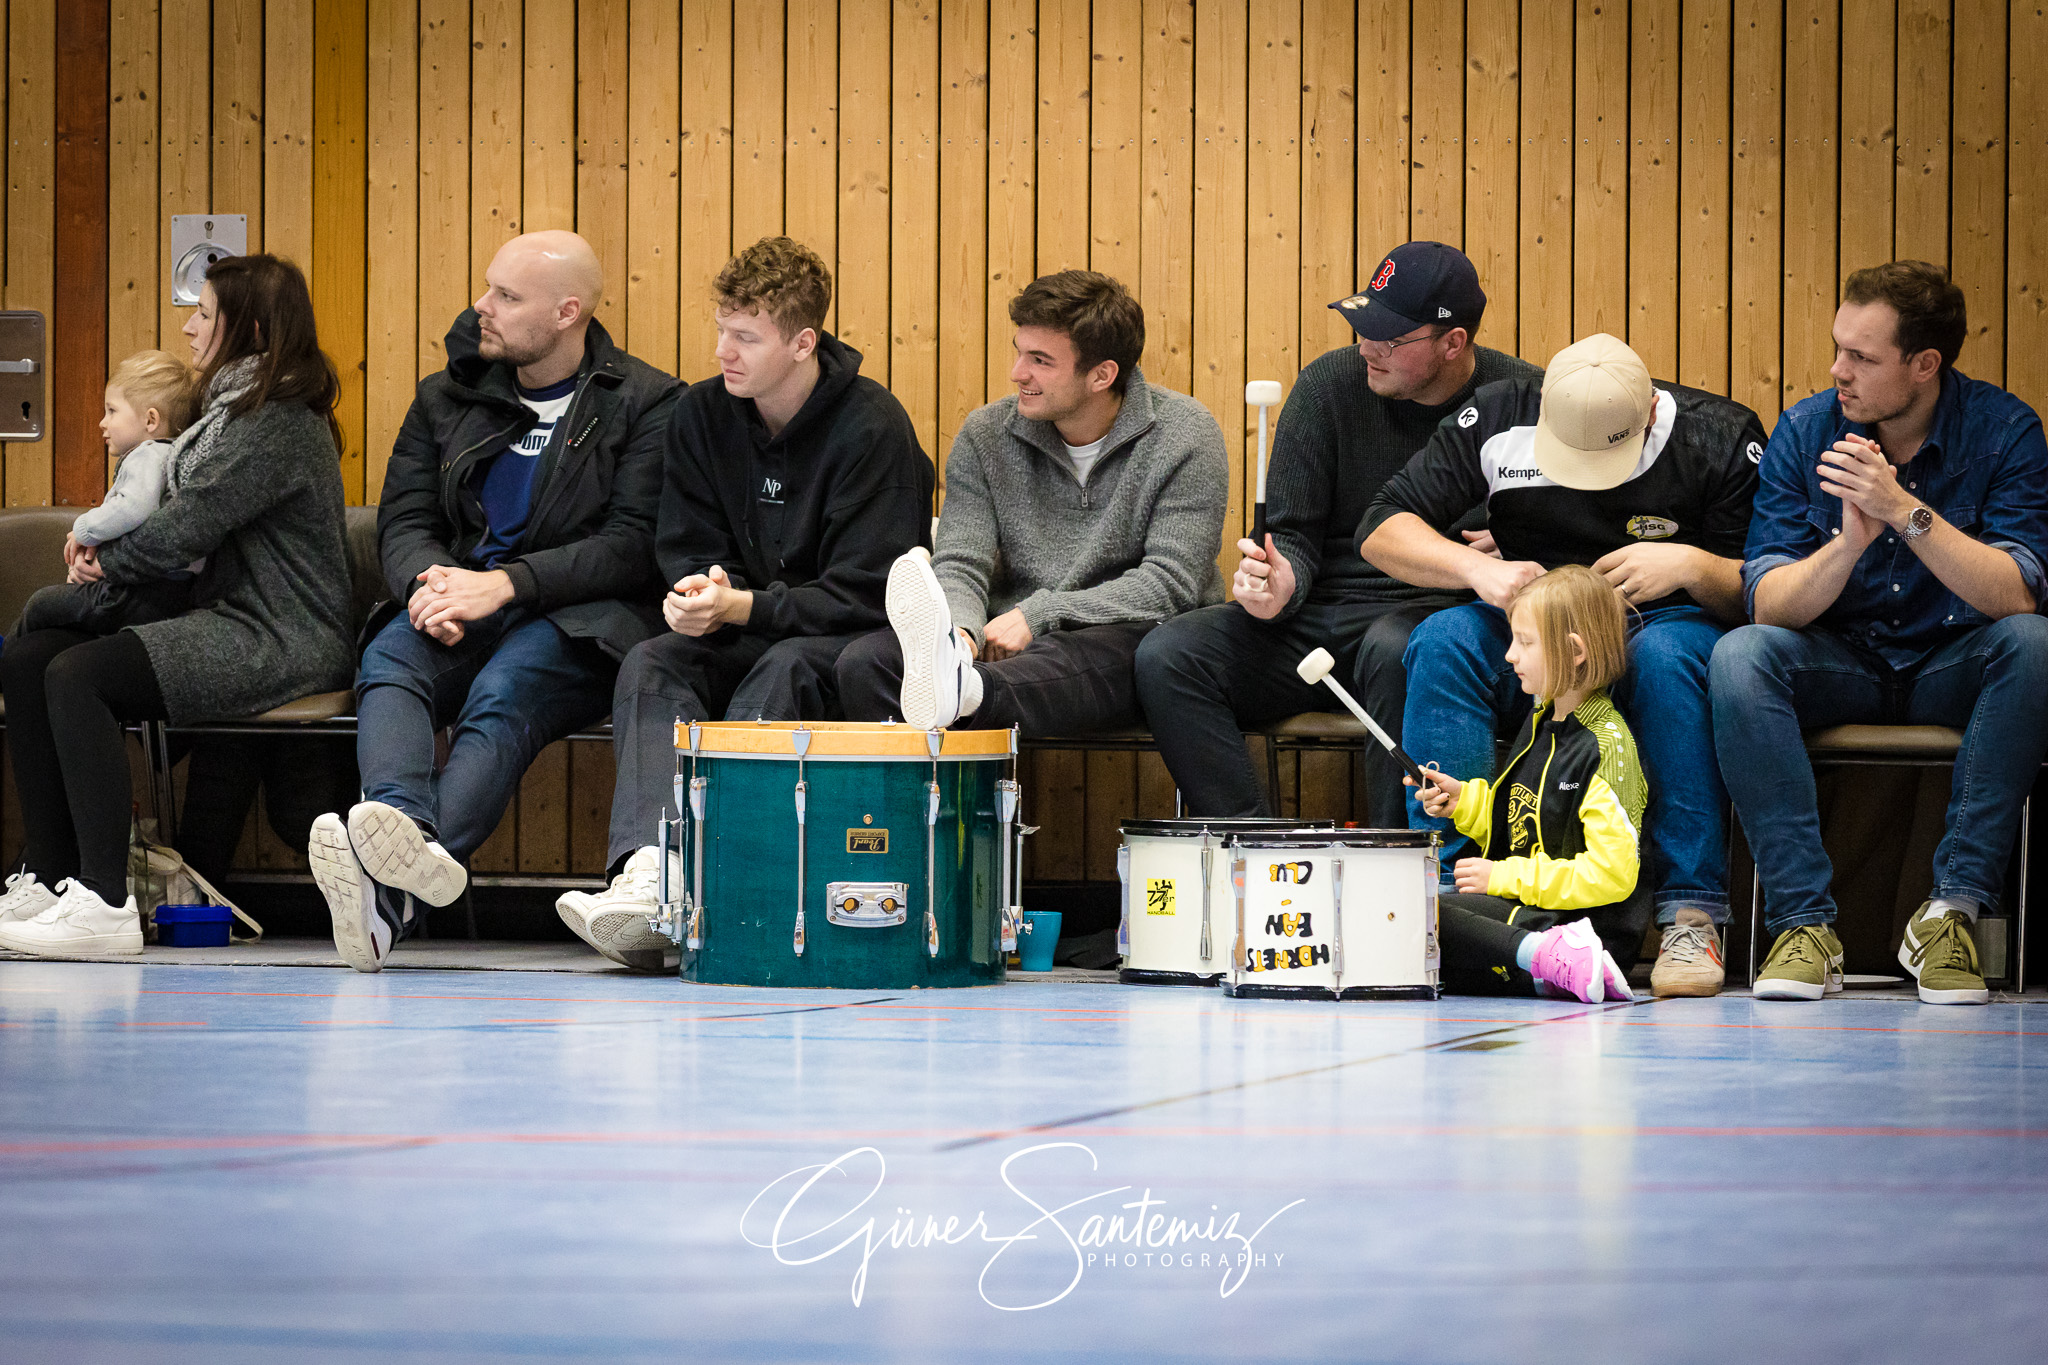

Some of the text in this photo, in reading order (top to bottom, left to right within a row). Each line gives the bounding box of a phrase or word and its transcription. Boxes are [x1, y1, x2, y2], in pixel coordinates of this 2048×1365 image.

[1371, 259, 1396, 291] B
[1607, 428, 1630, 444] VANS
[1640, 523, 1666, 531] HSG
[853, 837, 885, 851] Pearl
[1269, 861, 1313, 885] CLUB
[1265, 912, 1313, 937] FAN
